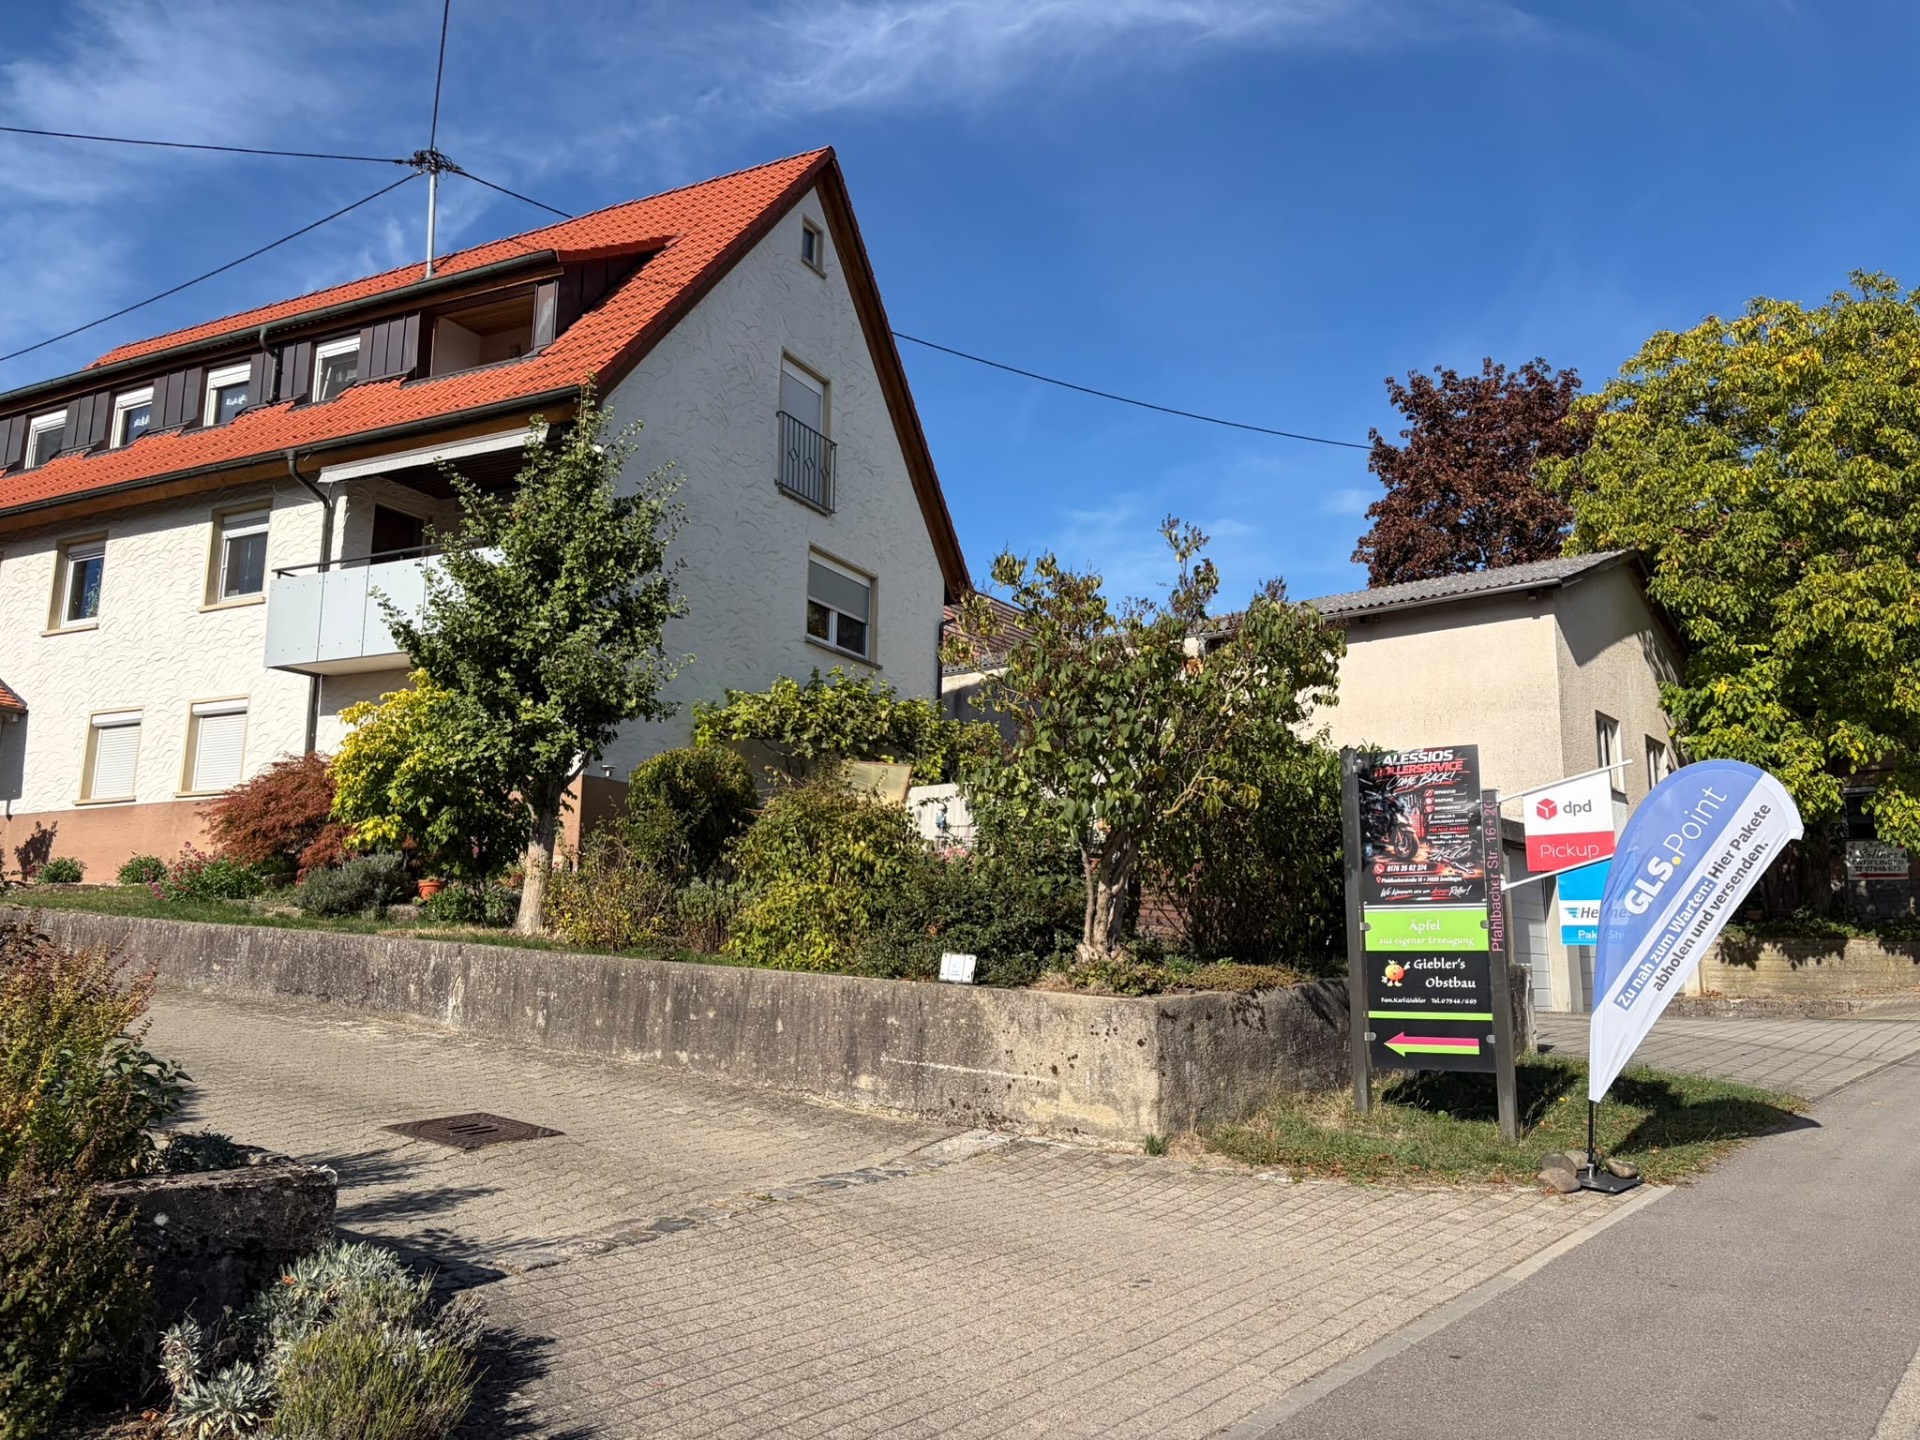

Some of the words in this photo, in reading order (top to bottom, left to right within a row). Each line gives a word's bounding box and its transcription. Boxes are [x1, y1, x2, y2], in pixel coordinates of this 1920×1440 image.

[1382, 749, 1454, 766] ALESSIOS
[1374, 761, 1464, 777] ROLLERSERVICE
[1386, 774, 1417, 790] COME
[1417, 770, 1456, 788] BACK!
[1562, 799, 1592, 817] dpd
[1485, 827, 1497, 843] 16
[1487, 848, 1499, 869] Str.
[1540, 842, 1600, 859] Pickup
[1489, 873, 1504, 952] Pfahlbacher
[1617, 989, 1637, 1007] Zu
[1632, 962, 1655, 989] nah
[1650, 933, 1676, 963] zum
[1668, 880, 1713, 933] Warten:
[1707, 850, 1735, 880] Hier
[1729, 804, 1771, 852] Pakete
[1653, 938, 1696, 992] abholen
[1691, 909, 1715, 938] und
[1710, 842, 1769, 911] versenden.
[1409, 918, 1441, 935] Äpfel
[1378, 937, 1393, 945] aus
[1394, 937, 1425, 947] eigener
[1427, 936, 1475, 947] Erzeugung
[1425, 976, 1477, 989] Obstbau
